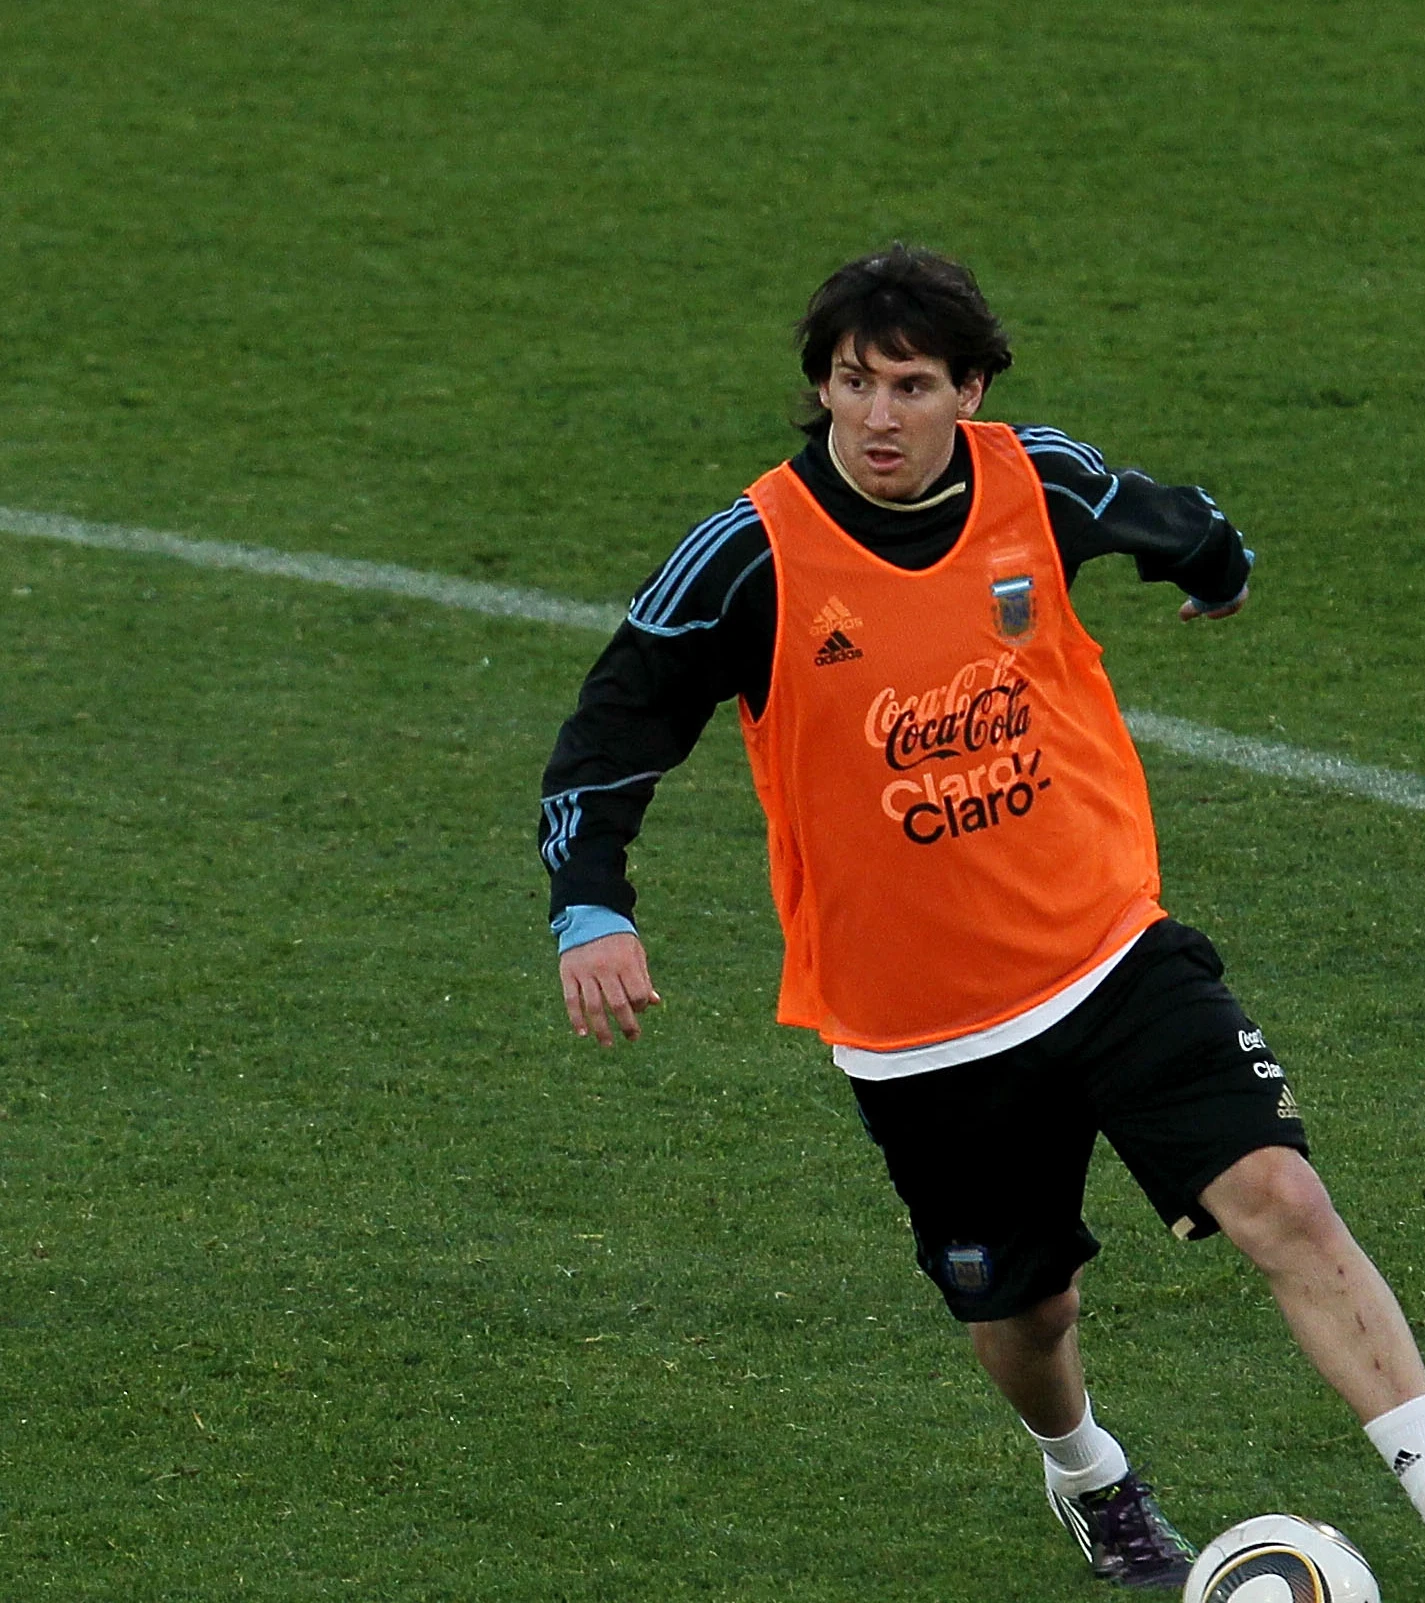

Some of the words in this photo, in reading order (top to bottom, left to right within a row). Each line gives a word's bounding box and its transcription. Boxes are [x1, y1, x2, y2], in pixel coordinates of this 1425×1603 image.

[814, 648, 864, 667] adidas
[886, 678, 1032, 771] Coca-Cola
[903, 782, 1034, 845] Claro
[1253, 1060, 1285, 1078] Cla
